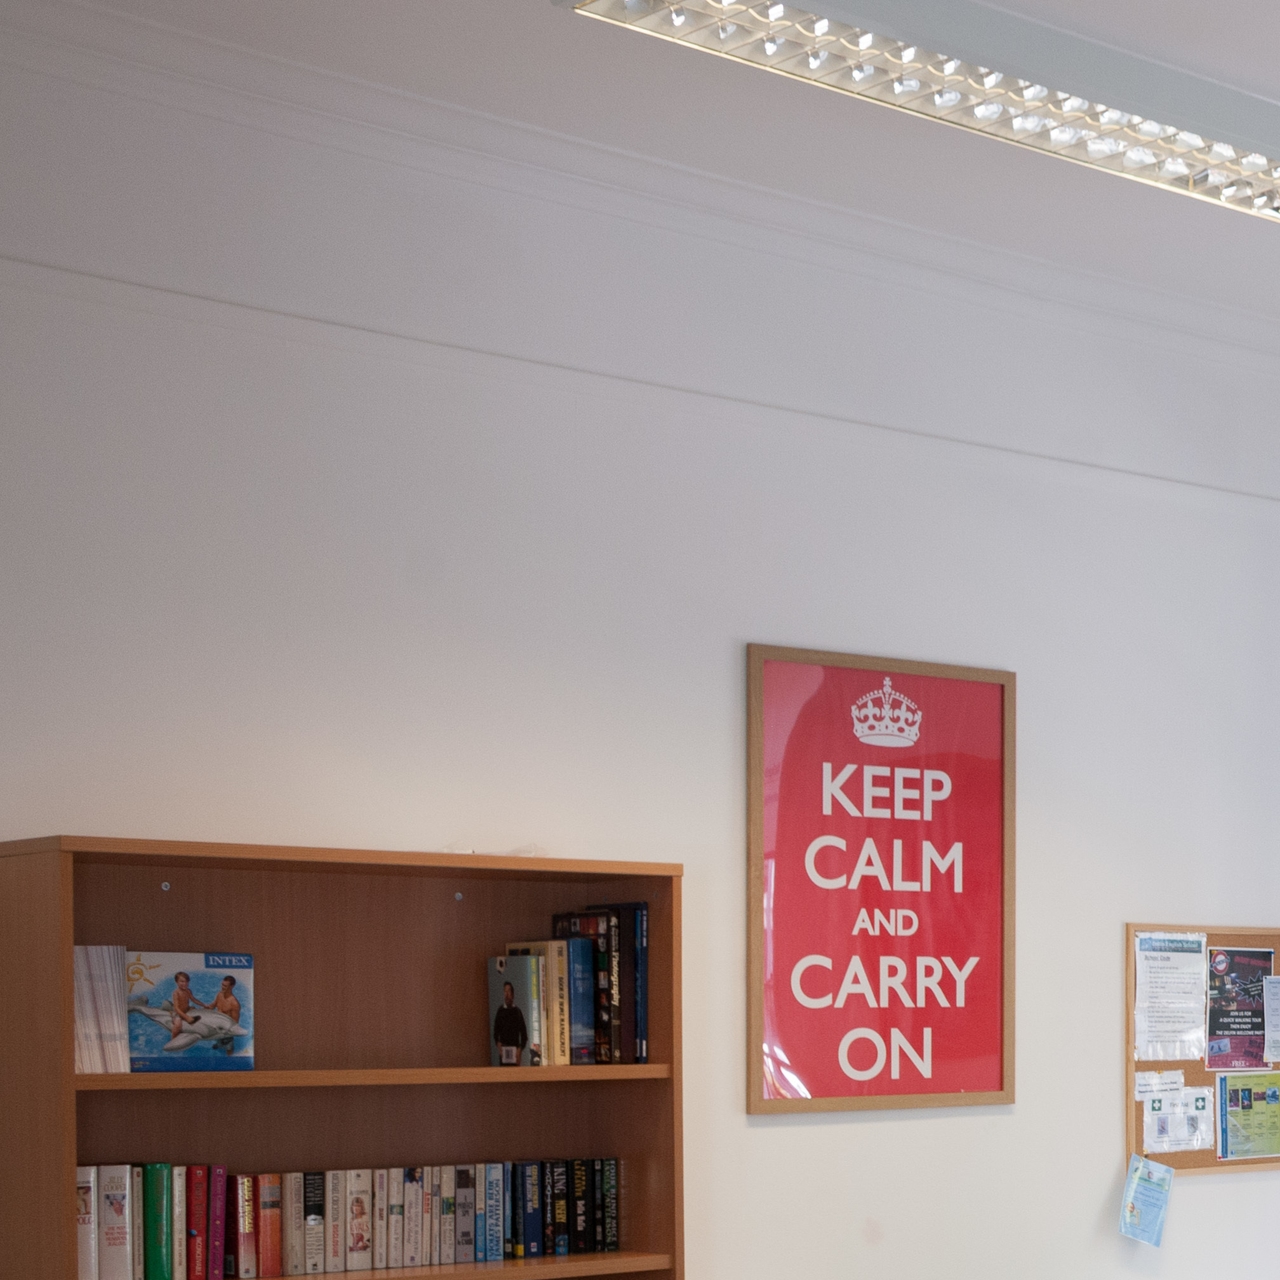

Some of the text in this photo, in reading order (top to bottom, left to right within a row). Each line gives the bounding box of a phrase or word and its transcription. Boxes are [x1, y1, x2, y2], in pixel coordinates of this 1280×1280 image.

[822, 762, 952, 821] KEEP
[804, 834, 963, 893] CALM
[851, 908, 919, 936] AND
[208, 956, 248, 966] INTEX
[611, 951, 620, 1007] Photography
[790, 954, 980, 1010] CARRY
[838, 1027, 933, 1081] ON
[554, 1167, 566, 1223] KING MISERY
